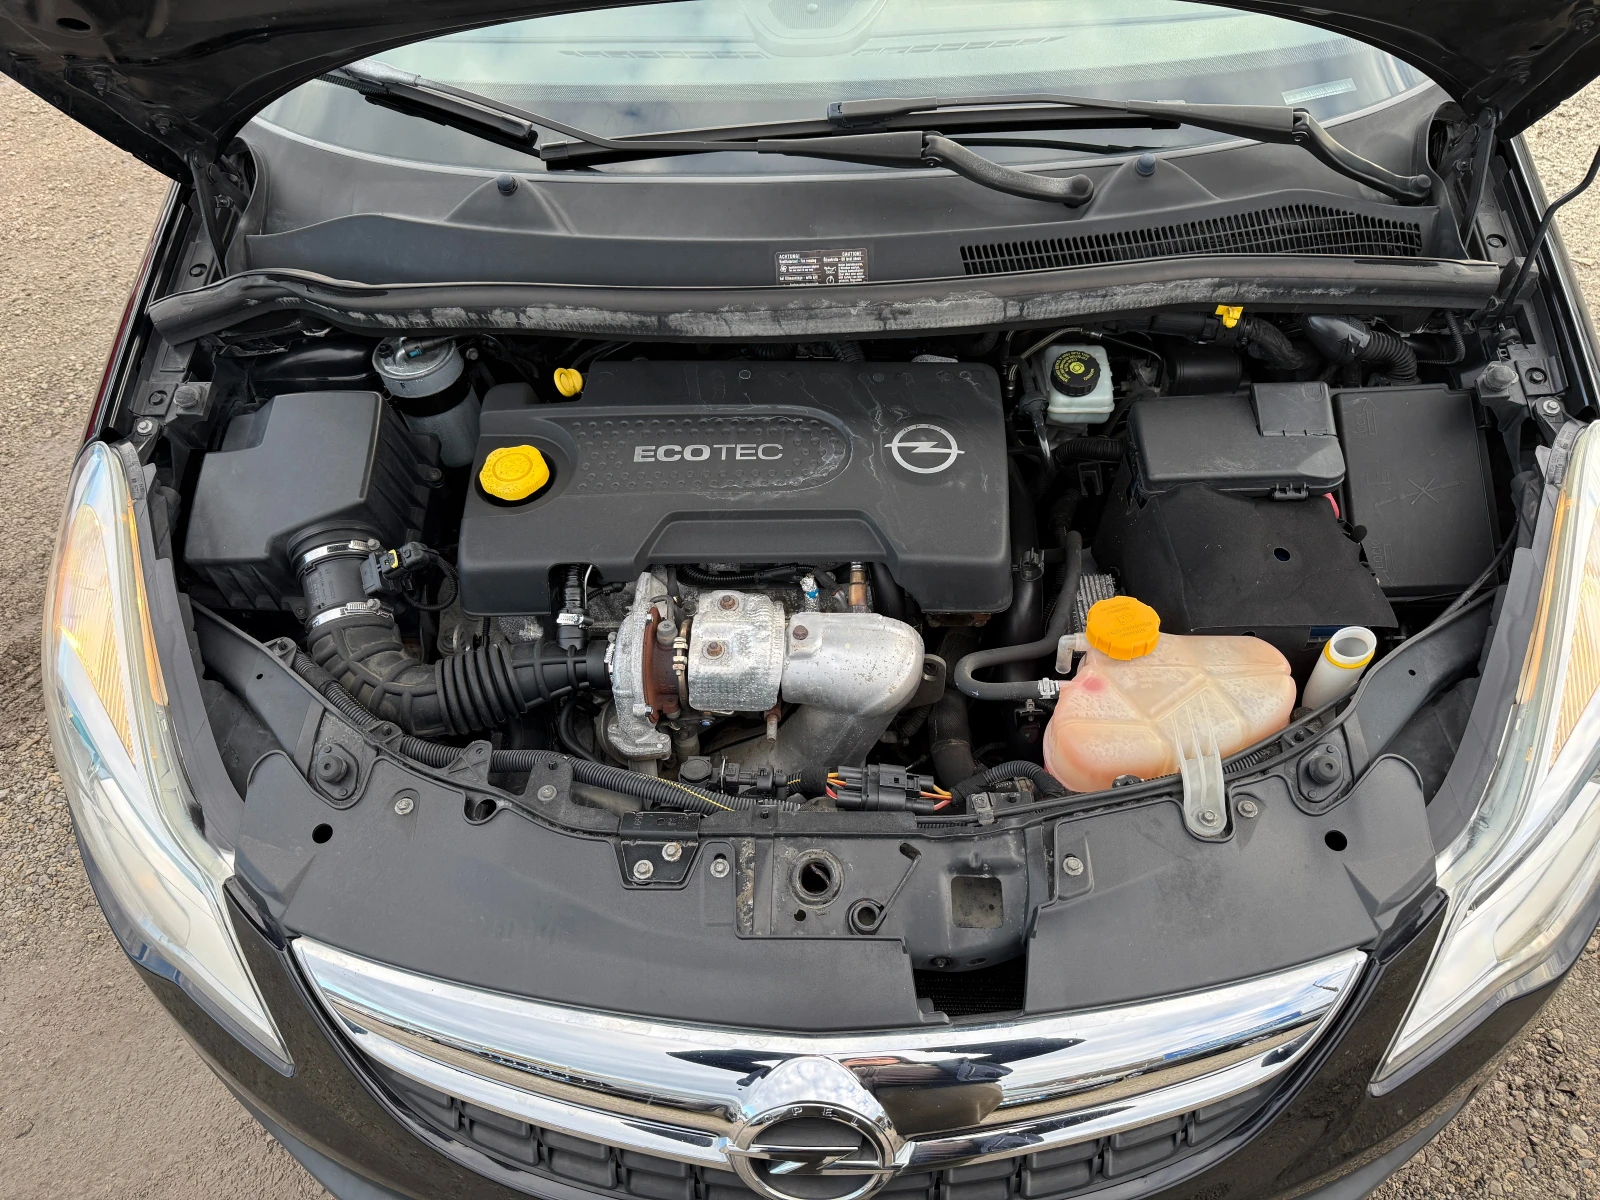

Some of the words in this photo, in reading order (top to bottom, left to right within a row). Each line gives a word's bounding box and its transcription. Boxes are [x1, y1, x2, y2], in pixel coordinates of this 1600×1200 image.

[633, 443, 784, 463] ECOTEC
[1370, 541, 1383, 569] LOCK
[763, 1106, 859, 1127] OPEL
